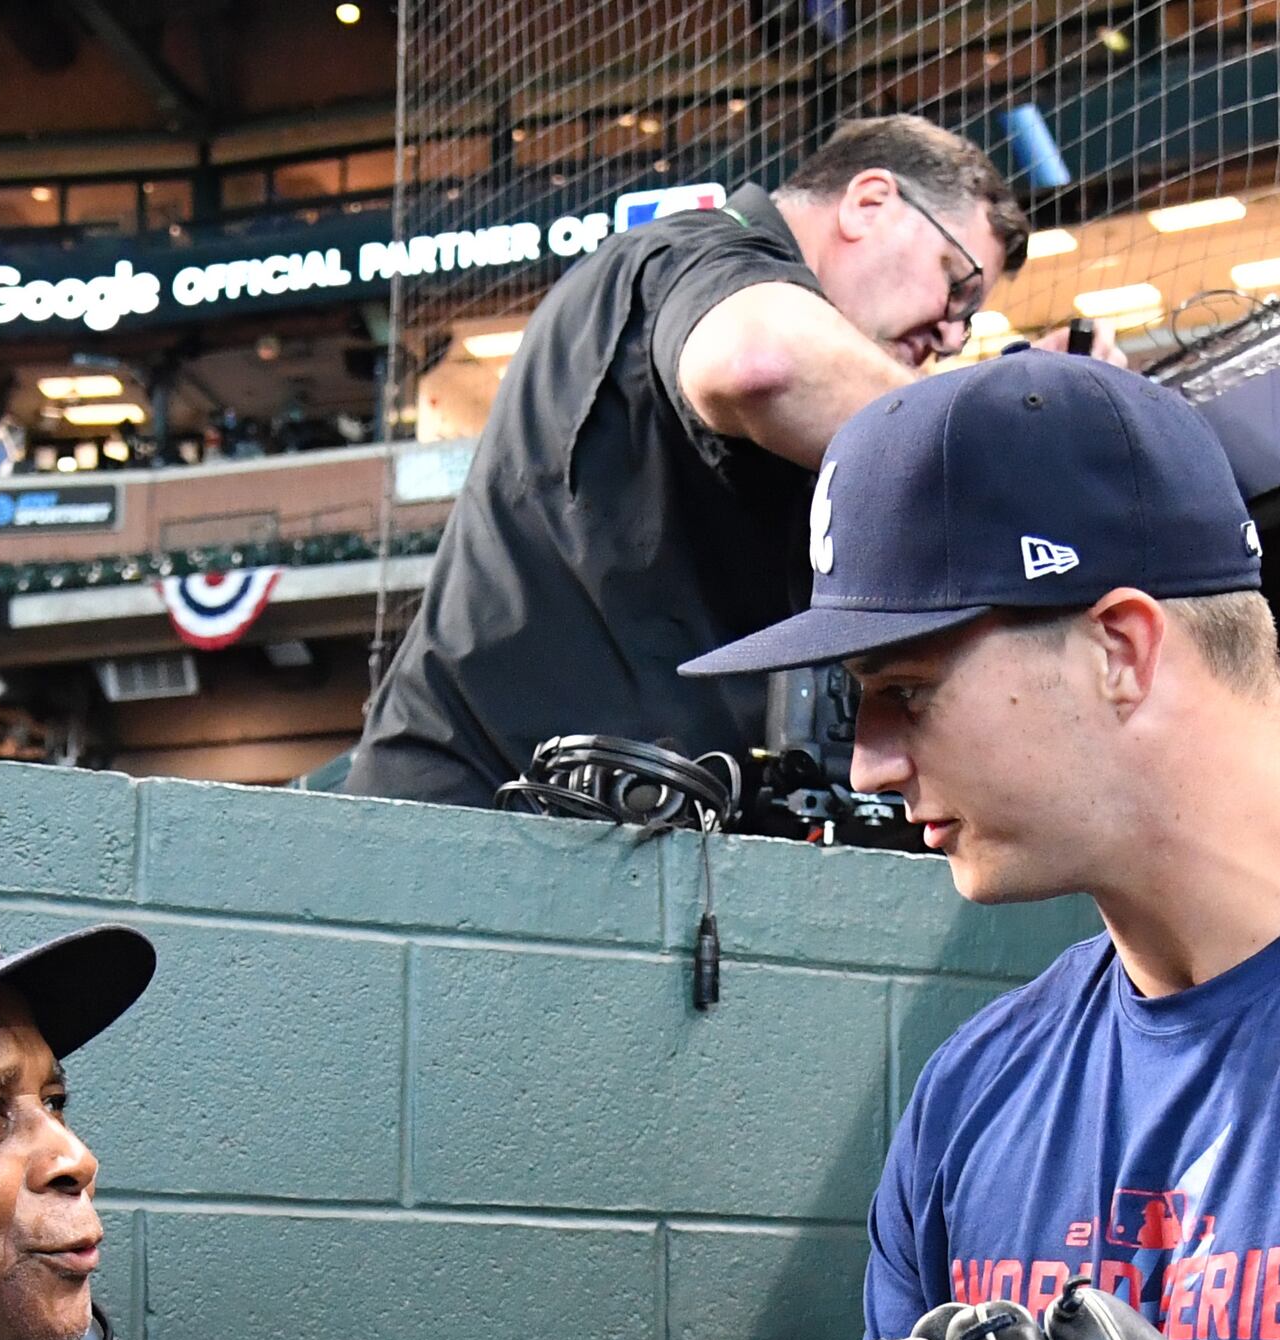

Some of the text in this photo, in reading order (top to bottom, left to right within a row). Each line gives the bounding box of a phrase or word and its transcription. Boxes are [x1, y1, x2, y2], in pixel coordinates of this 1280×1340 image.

[172, 248, 351, 306] OFFICIAL
[359, 222, 541, 282] PARTNER
[548, 213, 609, 256] OF
